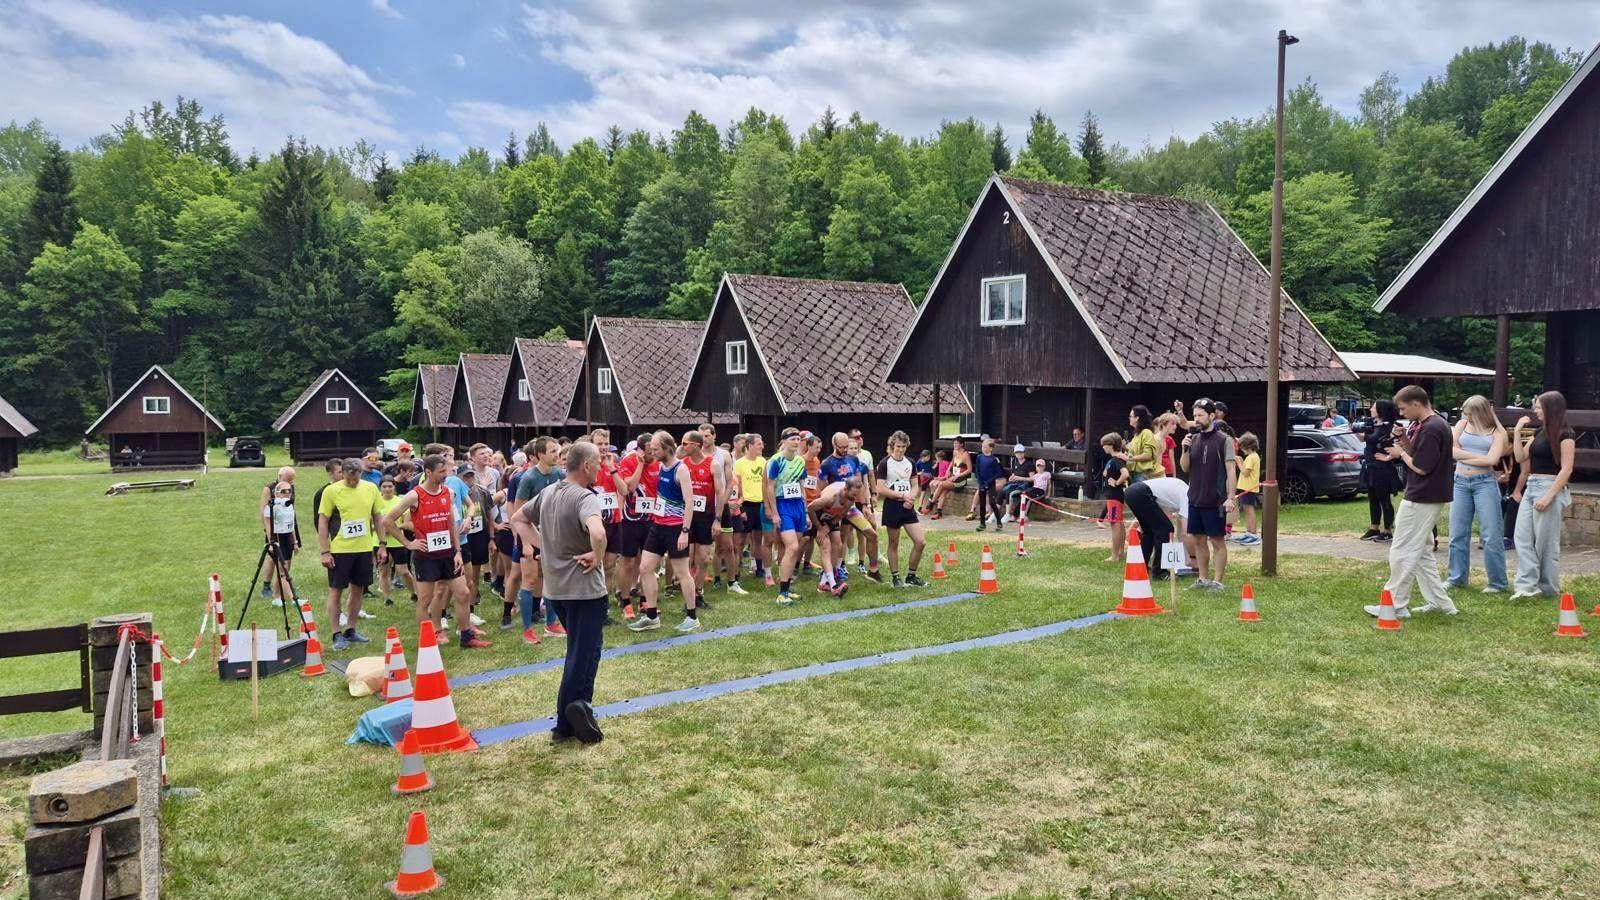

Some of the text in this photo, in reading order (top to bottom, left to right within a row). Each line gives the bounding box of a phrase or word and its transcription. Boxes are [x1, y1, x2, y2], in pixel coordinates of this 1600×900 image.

[1003, 211, 1010, 224] 2
[604, 497, 613, 505] 79
[348, 524, 363, 533] 213
[432, 536, 447, 546] 195
